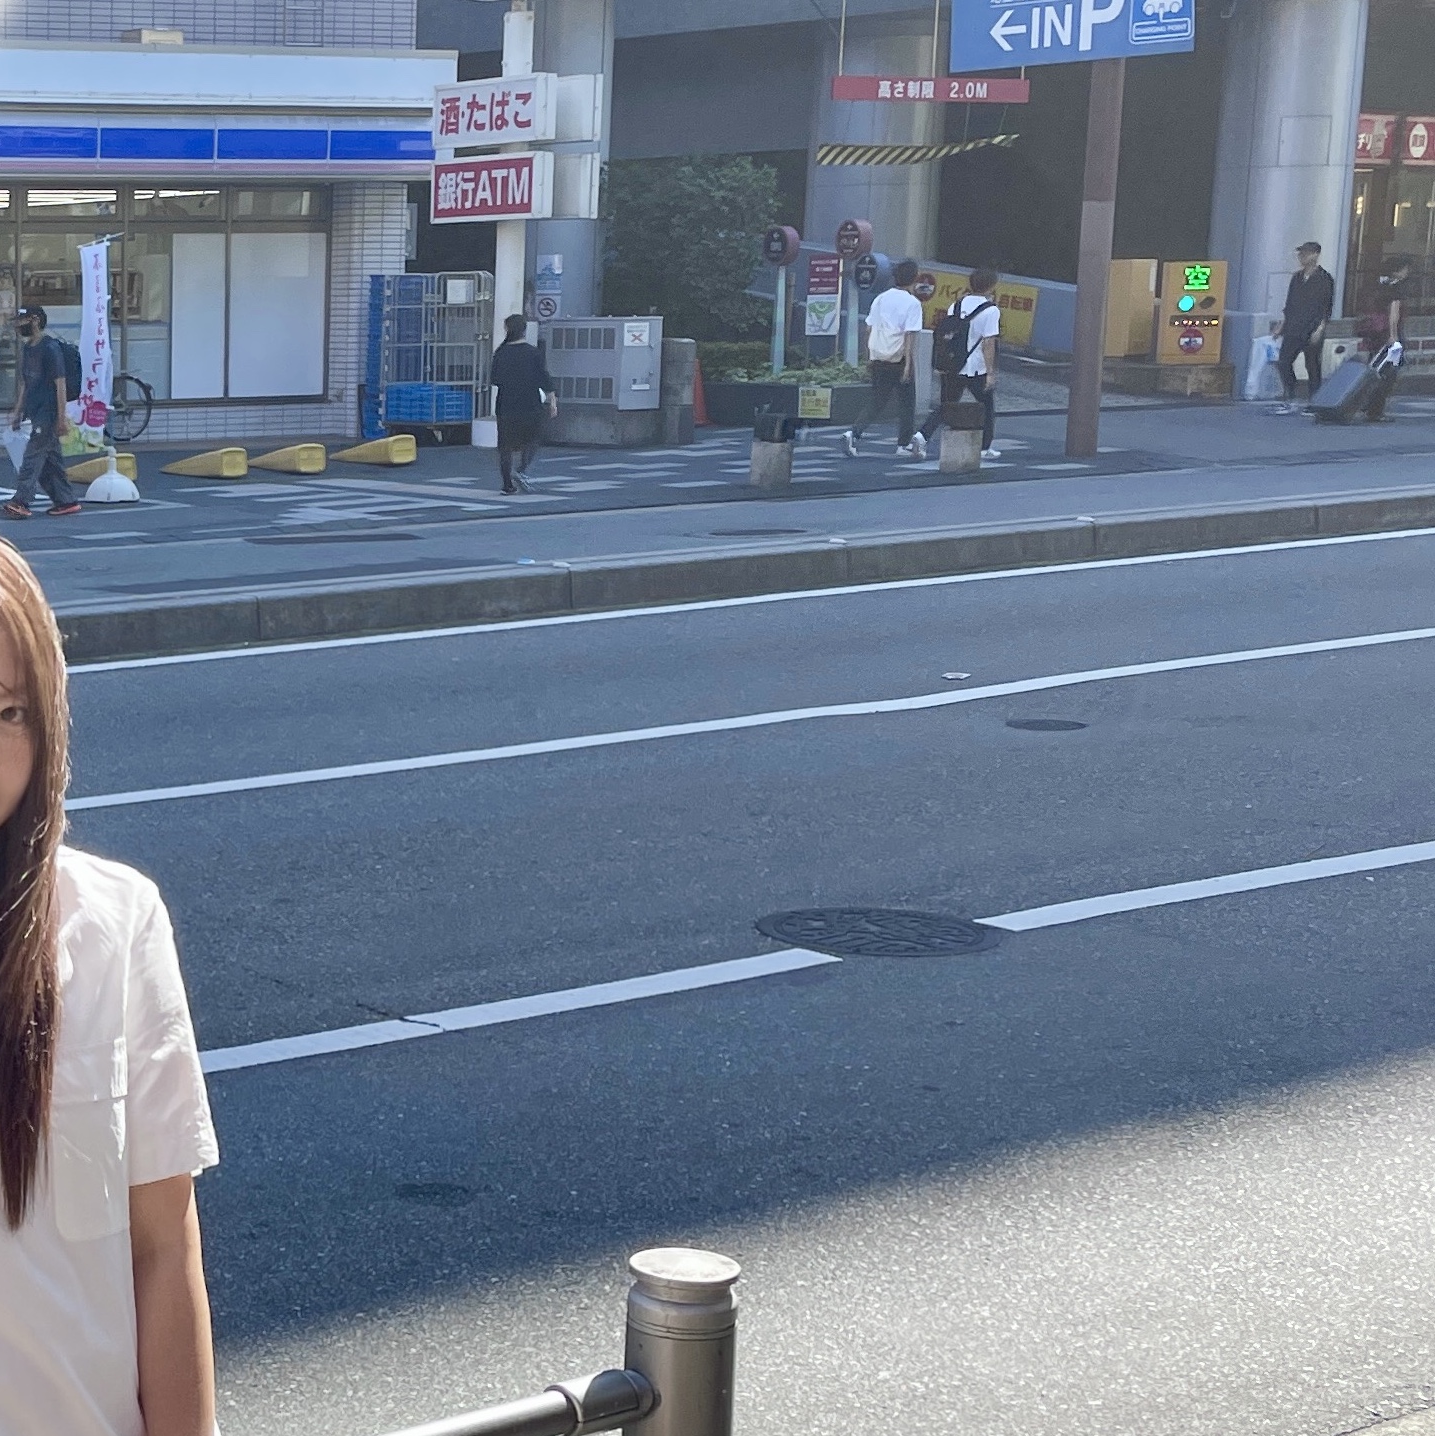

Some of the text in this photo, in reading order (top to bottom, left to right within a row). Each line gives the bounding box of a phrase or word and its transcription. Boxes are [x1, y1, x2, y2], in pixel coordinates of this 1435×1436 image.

[1031, 3, 1073, 49] IN
[878, 80, 988, 99] 高さ制限 2.0M
[437, 166, 530, 210] 銀行ATM
[1184, 264, 1211, 290] 空
